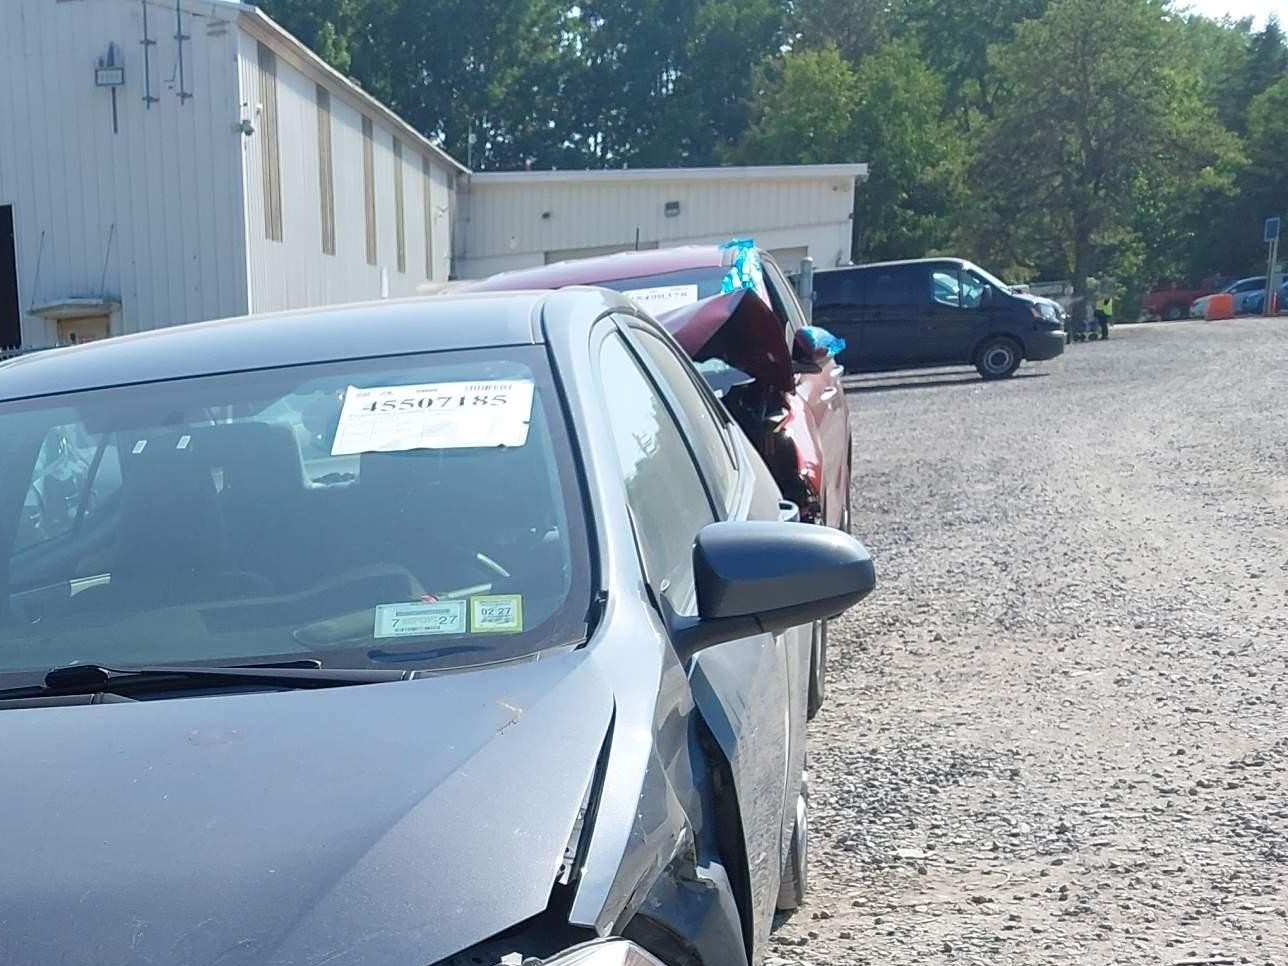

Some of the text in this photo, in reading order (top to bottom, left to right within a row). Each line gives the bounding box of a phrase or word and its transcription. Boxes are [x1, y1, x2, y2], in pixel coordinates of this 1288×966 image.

[362, 394, 508, 412] 45507185
[391, 615, 458, 628] 7 27
